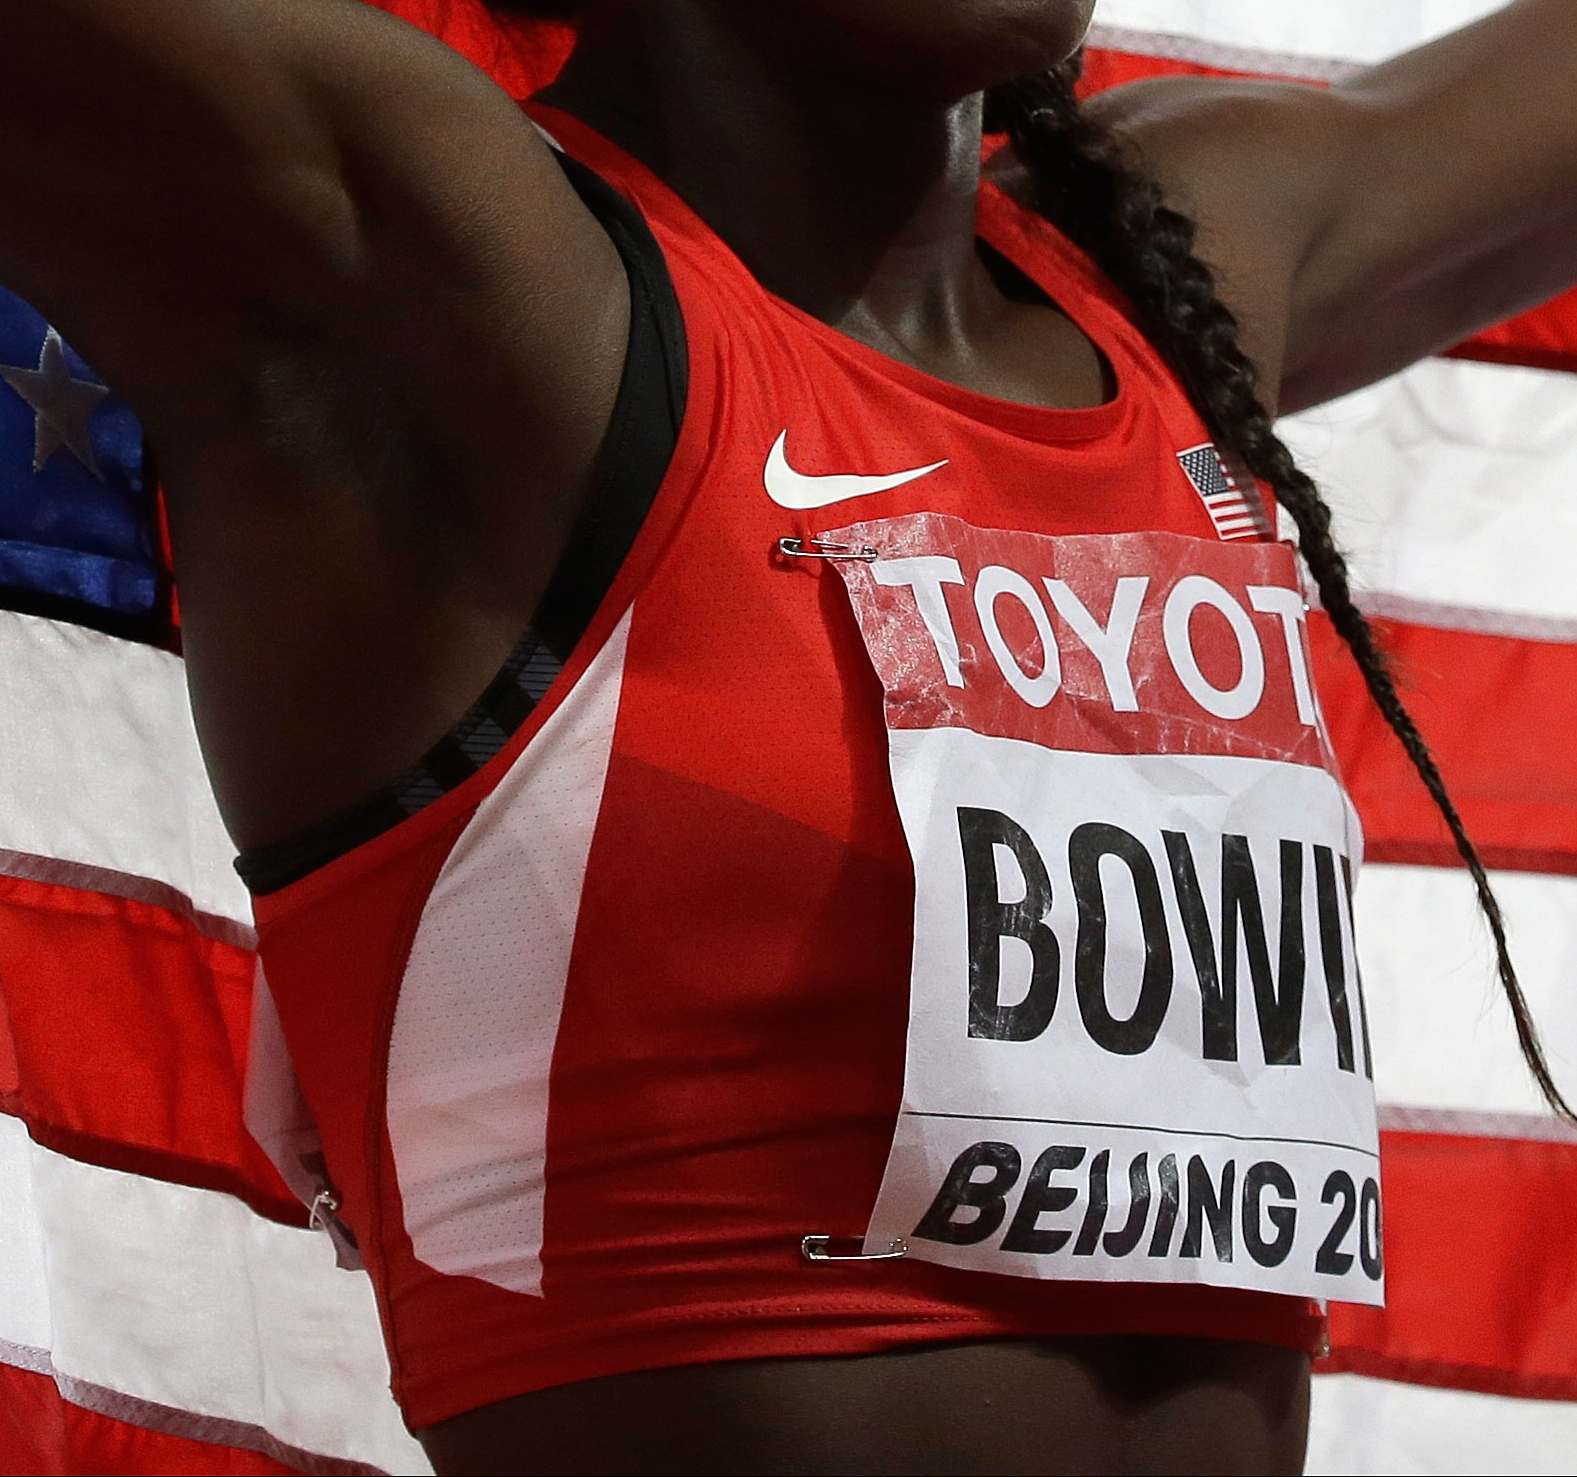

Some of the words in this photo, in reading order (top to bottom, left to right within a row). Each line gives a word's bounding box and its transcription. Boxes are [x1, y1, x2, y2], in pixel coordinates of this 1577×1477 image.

[875, 555, 1320, 736] TOYOT
[956, 806, 1374, 1083] BOWI
[911, 1141, 1297, 1268] BEIJING
